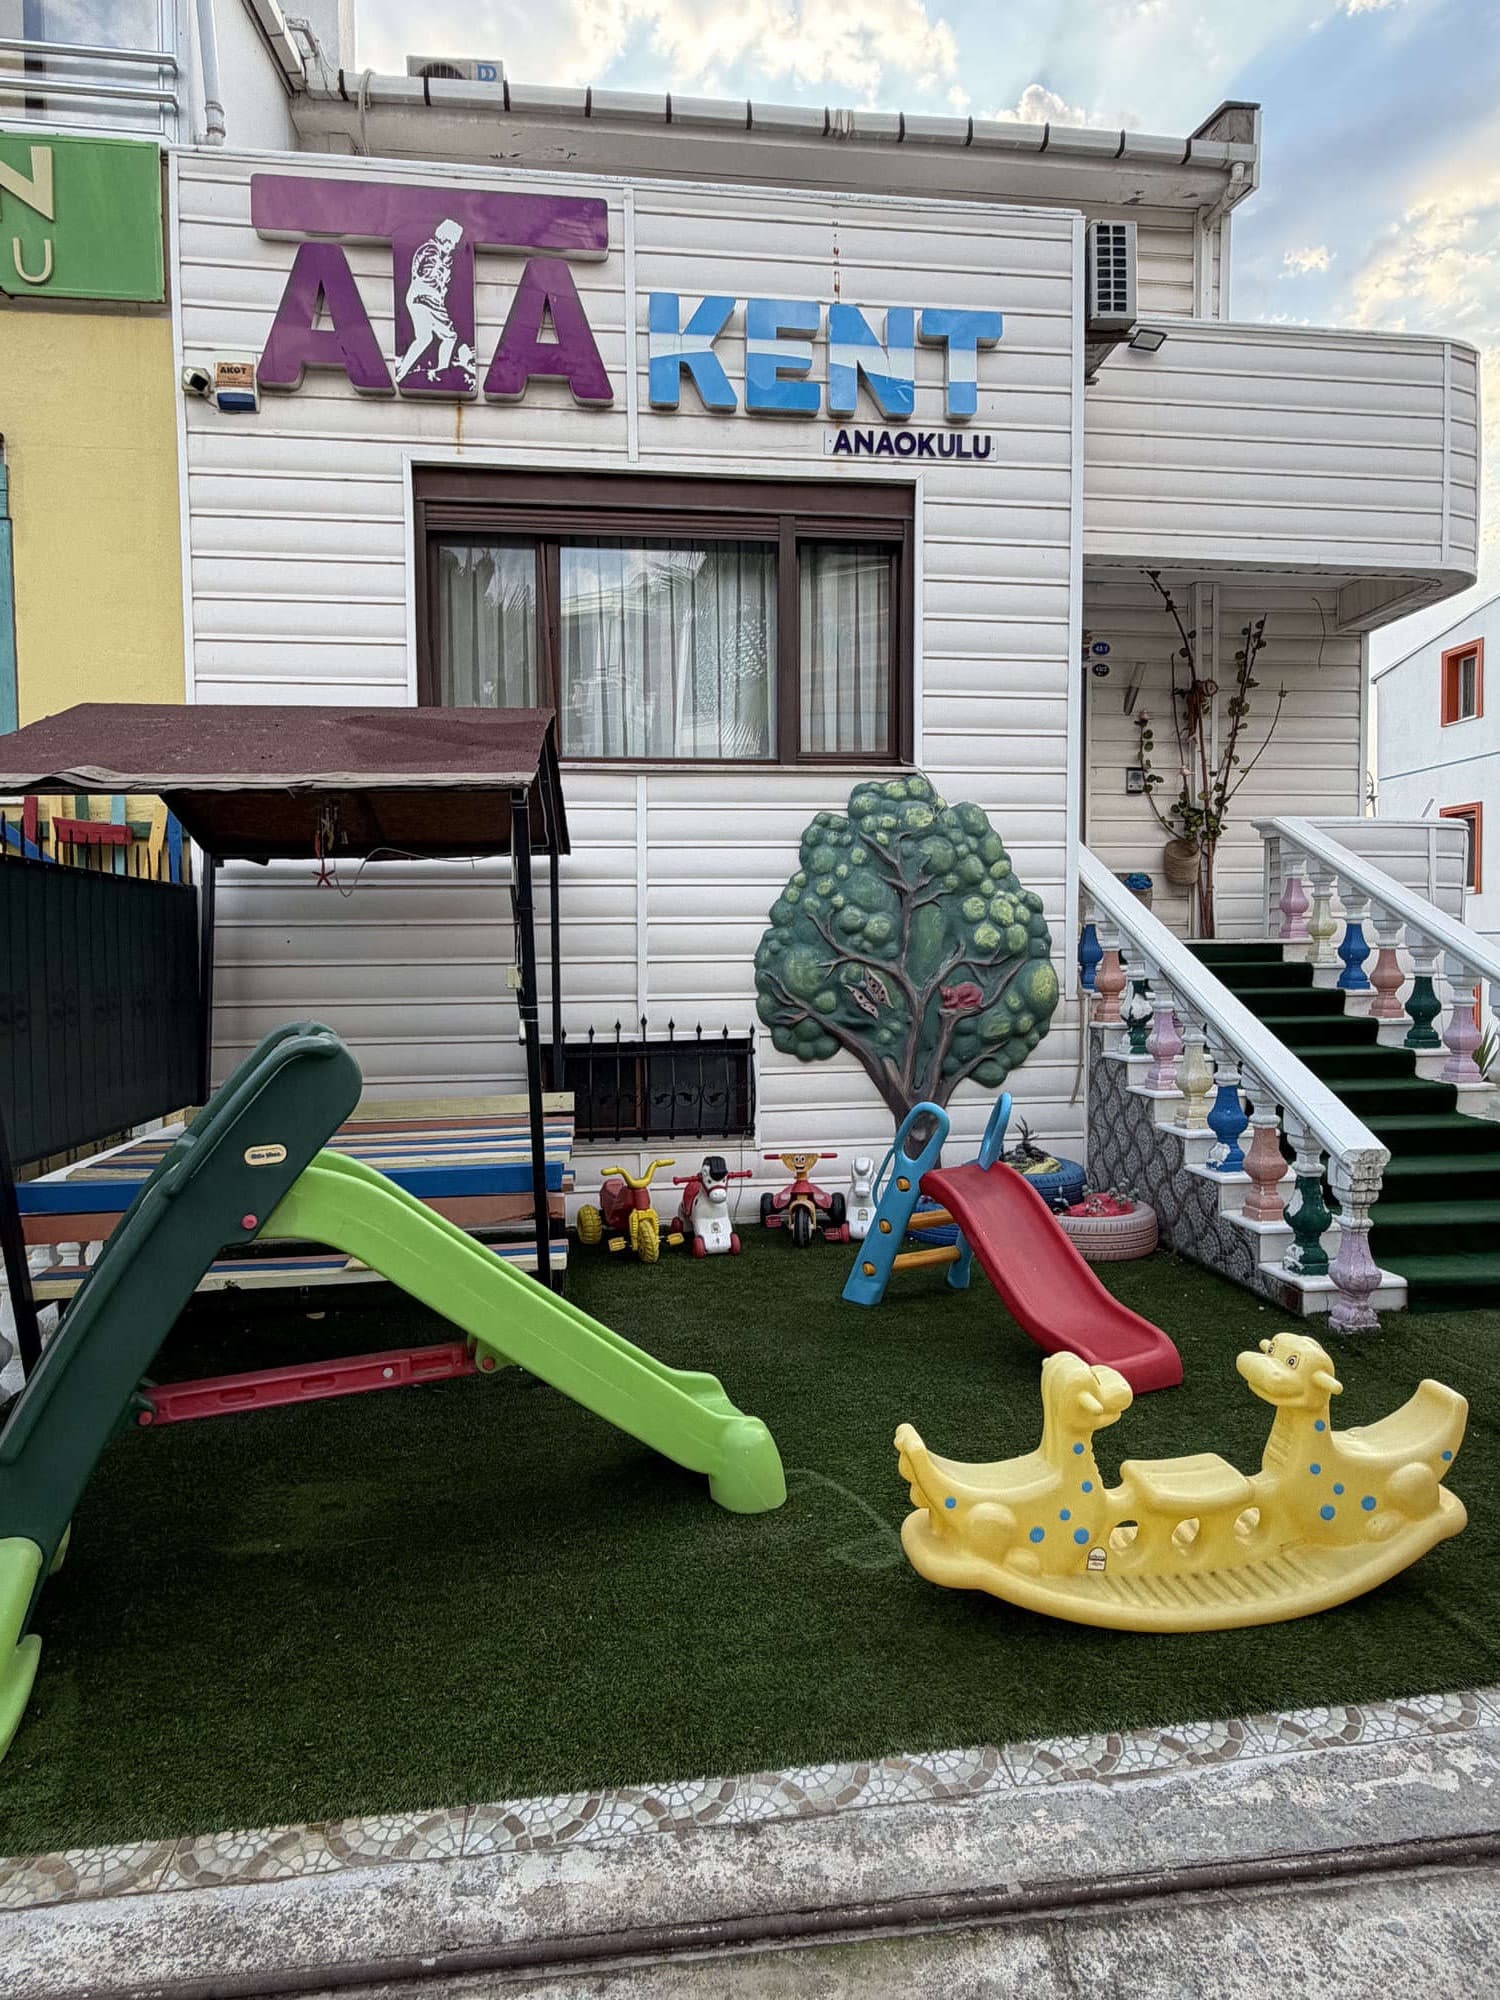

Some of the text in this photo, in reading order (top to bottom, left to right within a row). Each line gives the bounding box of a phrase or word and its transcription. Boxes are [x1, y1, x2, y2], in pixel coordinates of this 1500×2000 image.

[251, 173, 1003, 418] ATA KENT
[832, 430, 991, 459] ANAOKULU
